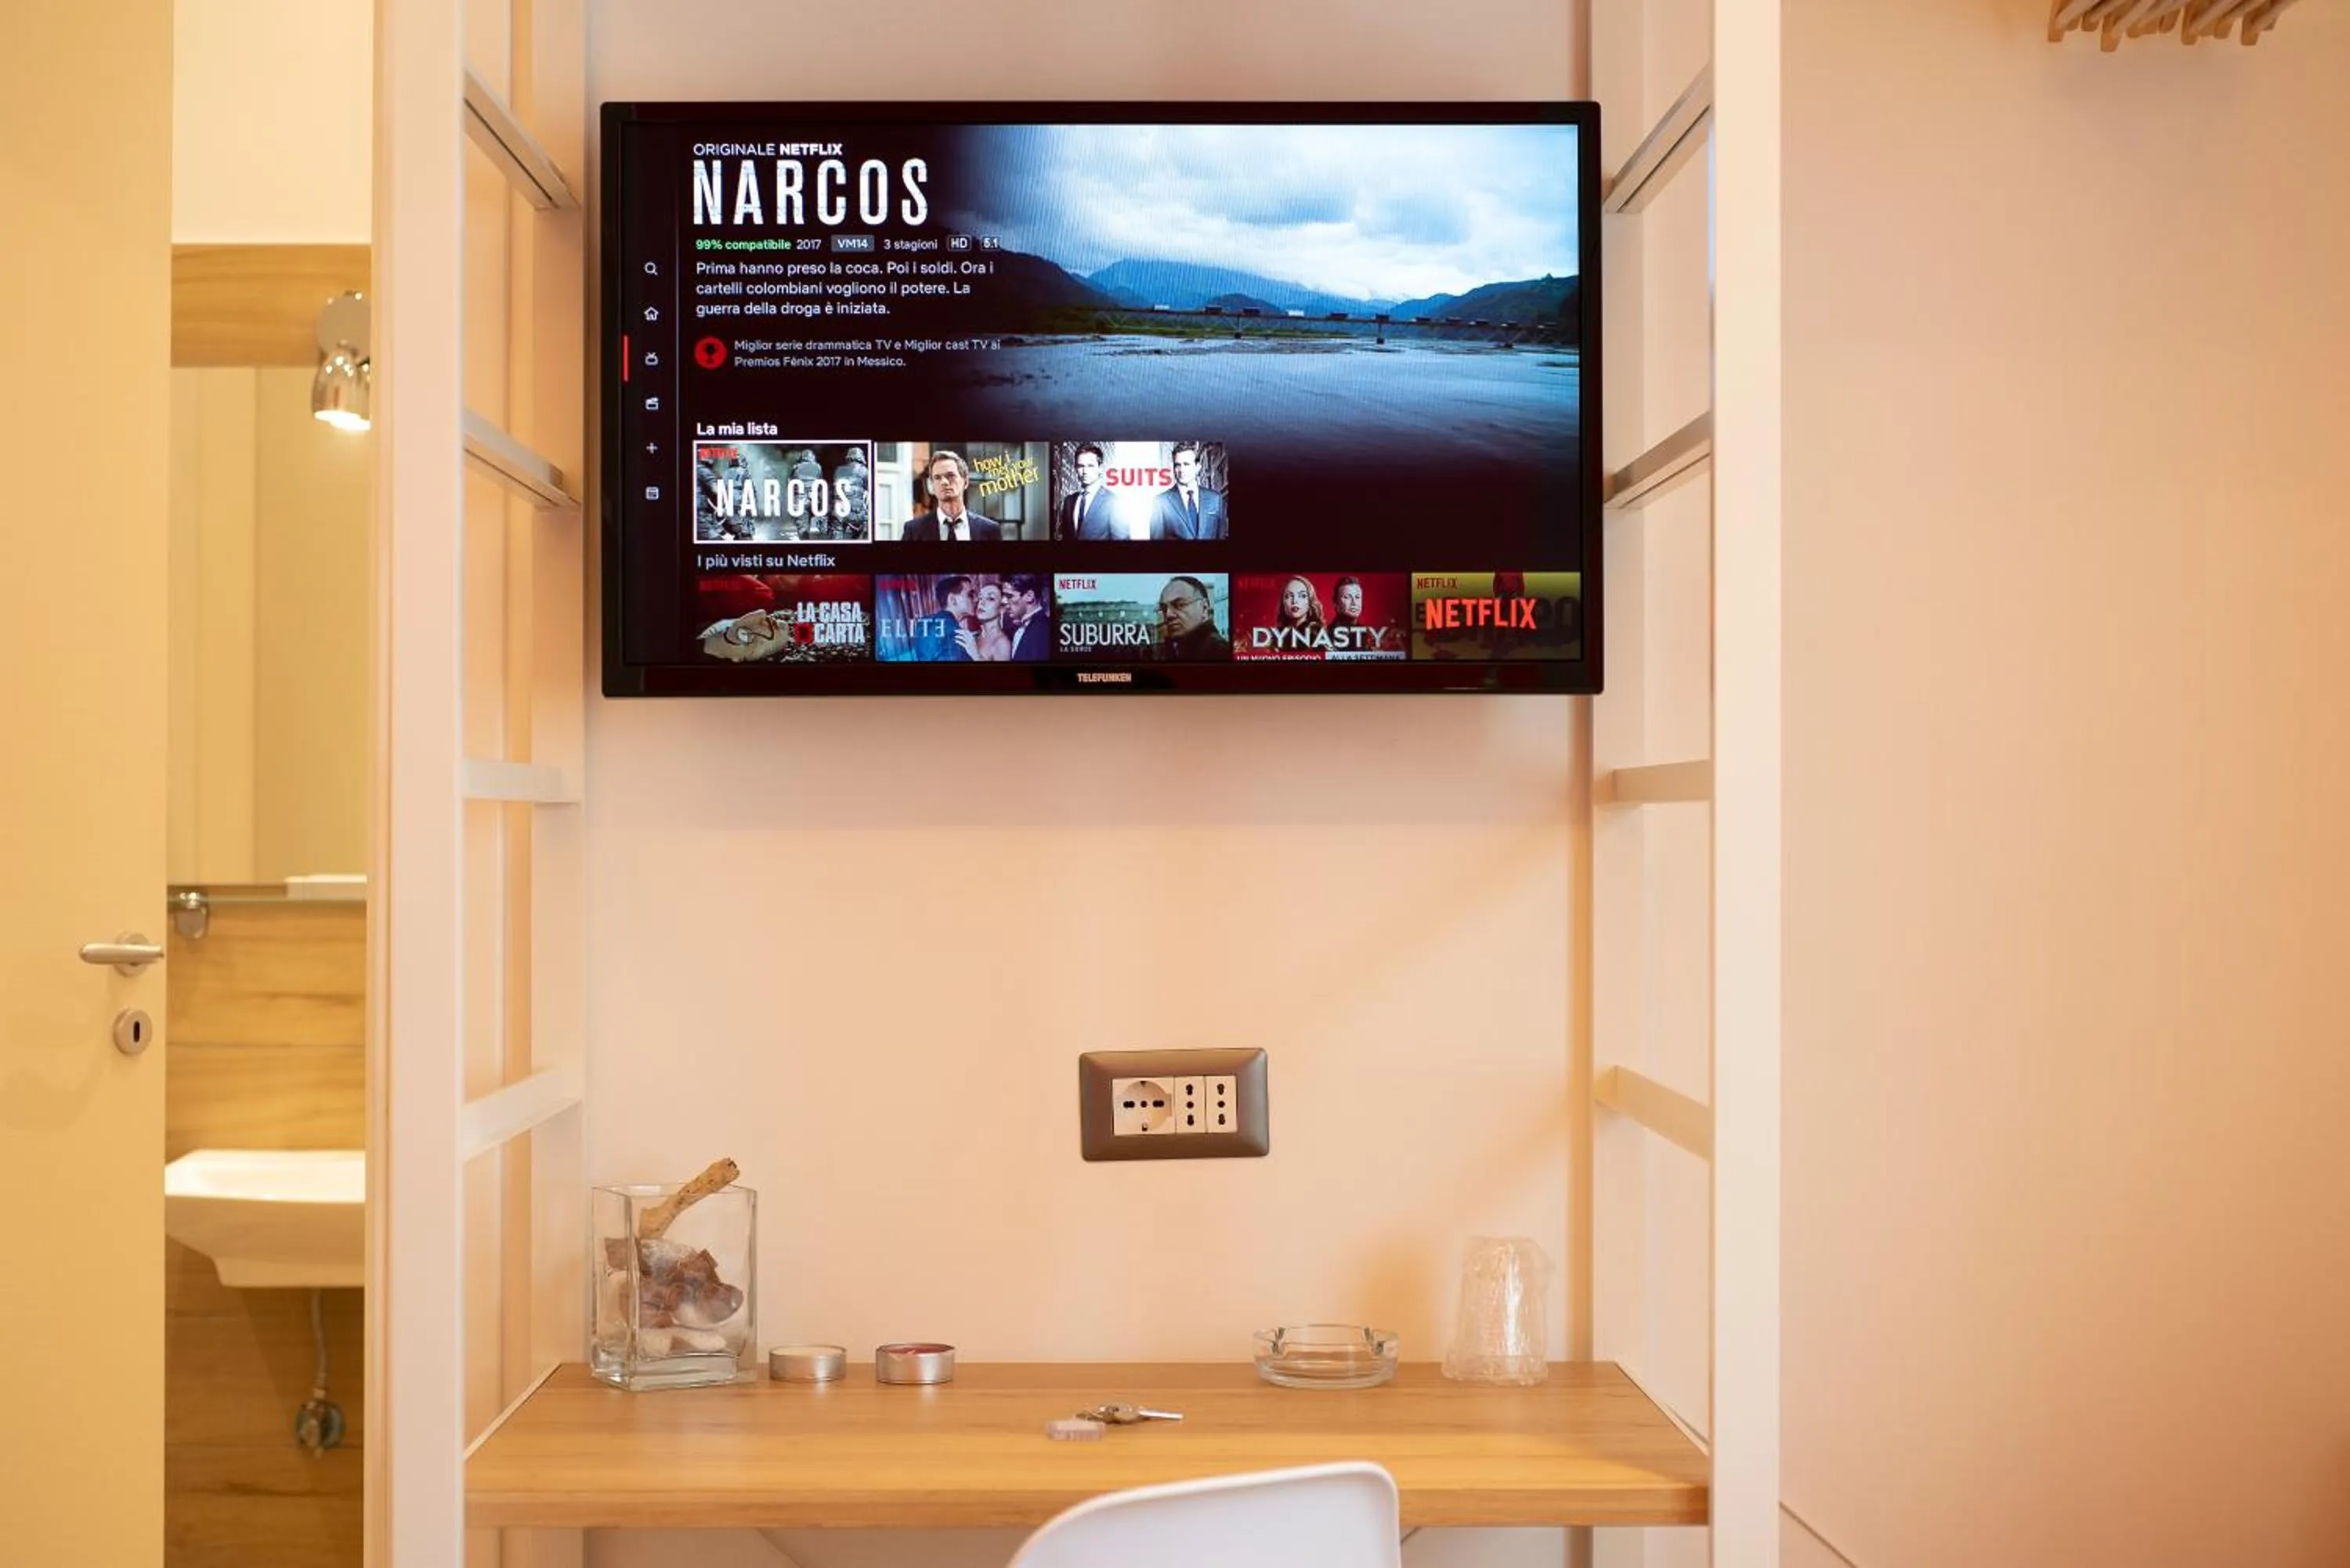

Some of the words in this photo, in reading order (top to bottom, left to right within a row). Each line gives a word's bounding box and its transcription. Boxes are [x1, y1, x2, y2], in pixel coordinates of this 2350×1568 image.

[693, 143, 776, 156] ORIGINALE
[779, 143, 843, 156] NETFLIX
[693, 158, 928, 226] NARCOS
[696, 239, 722, 250] 99%
[725, 239, 791, 252] compatibile
[796, 239, 822, 250] 2017
[837, 238, 869, 248] VM14
[884, 239, 891, 250] 3
[894, 239, 938, 251] stagioni
[950, 237, 967, 248] HD
[983, 238, 998, 248] 5.1
[696, 261, 736, 274] Prima
[739, 261, 784, 274] hanno
[787, 265, 826, 276] preso
[830, 261, 842, 274] la
[846, 264, 883, 274] coca.
[887, 261, 909, 274] Poi
[920, 261, 957, 274] soldi.
[960, 261, 986, 274] Ora
[989, 261, 994, 273] i
[696, 282, 743, 294] cartelli
[747, 282, 822, 294] colombiani
[826, 282, 886, 297] vogliono
[889, 282, 897, 294] il
[902, 283, 950, 297] potere.
[953, 282, 971, 294] La
[696, 305, 740, 317] guerra
[744, 302, 777, 314] della
[781, 302, 821, 317] droga
[825, 301, 833, 314] è
[837, 302, 891, 314] iniziata.
[734, 340, 773, 352] Miglior
[776, 340, 803, 350] serie
[804, 340, 872, 350] drammatica
[875, 339, 892, 350] TV
[905, 339, 942, 352] Miglior
[945, 340, 969, 350] cast
[971, 339, 989, 350] TV
[991, 339, 1000, 350] ai
[734, 356, 781, 367] Premios
[816, 356, 841, 367] 2017
[844, 356, 855, 367] in
[857, 356, 906, 367] Messico.
[697, 422, 715, 435] La
[718, 421, 745, 435] mia
[747, 421, 778, 435] lista
[974, 454, 1002, 473] how
[978, 466, 1039, 498] mother
[1105, 468, 1173, 487] SUITS
[717, 478, 851, 518] NARCOS
[706, 553, 728, 570] più
[731, 553, 762, 567] visti
[765, 556, 783, 567] su
[787, 553, 836, 567] Netflix
[1059, 578, 1097, 590] NETFLIX
[1417, 576, 1458, 590] NETFLIX
[797, 602, 815, 622] LA
[819, 602, 862, 622] CASA
[1426, 598, 1537, 630] NETFLIX
[814, 623, 866, 644] CARTA
[1059, 623, 1151, 646] SUBURRA
[1253, 627, 1388, 649] DYNASTY
[1077, 673, 1132, 683] TELEFUNKEN
